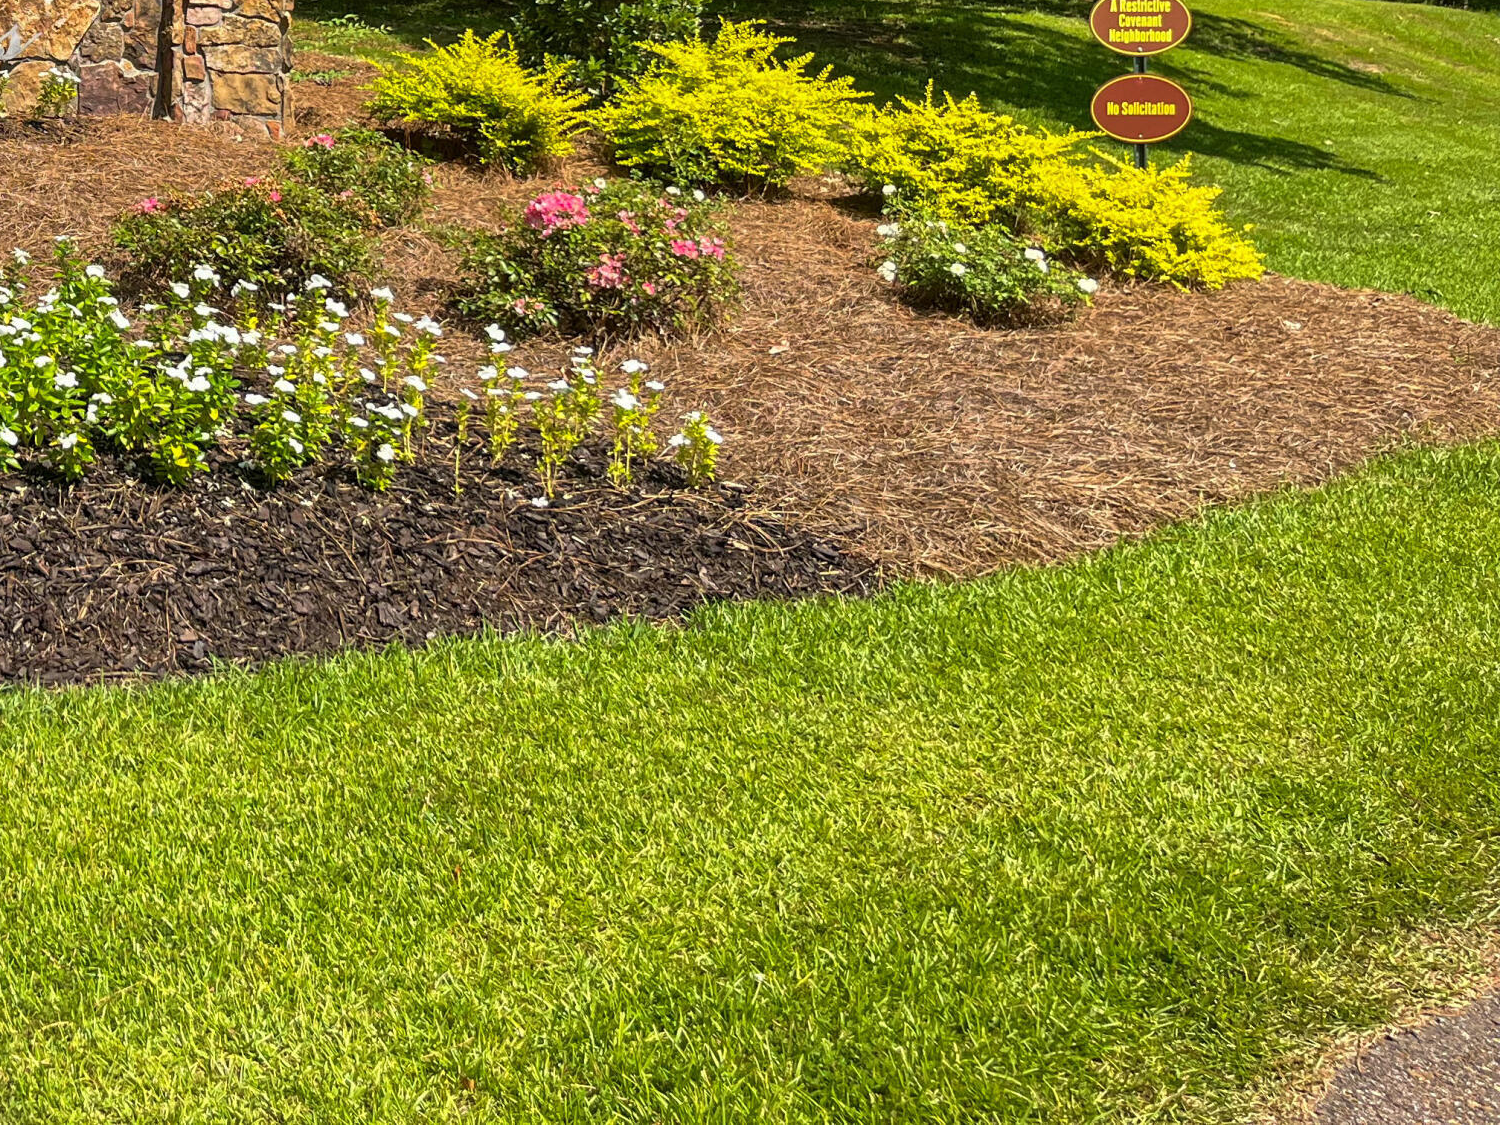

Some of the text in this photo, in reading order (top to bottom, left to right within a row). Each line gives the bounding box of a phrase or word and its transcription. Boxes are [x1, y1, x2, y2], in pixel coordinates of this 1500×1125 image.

[1110, 0, 1117, 13] A
[1118, 14, 1162, 27] Covenant
[1109, 29, 1172, 44] Neighborhood
[1107, 101, 1176, 116] No Solicitation
